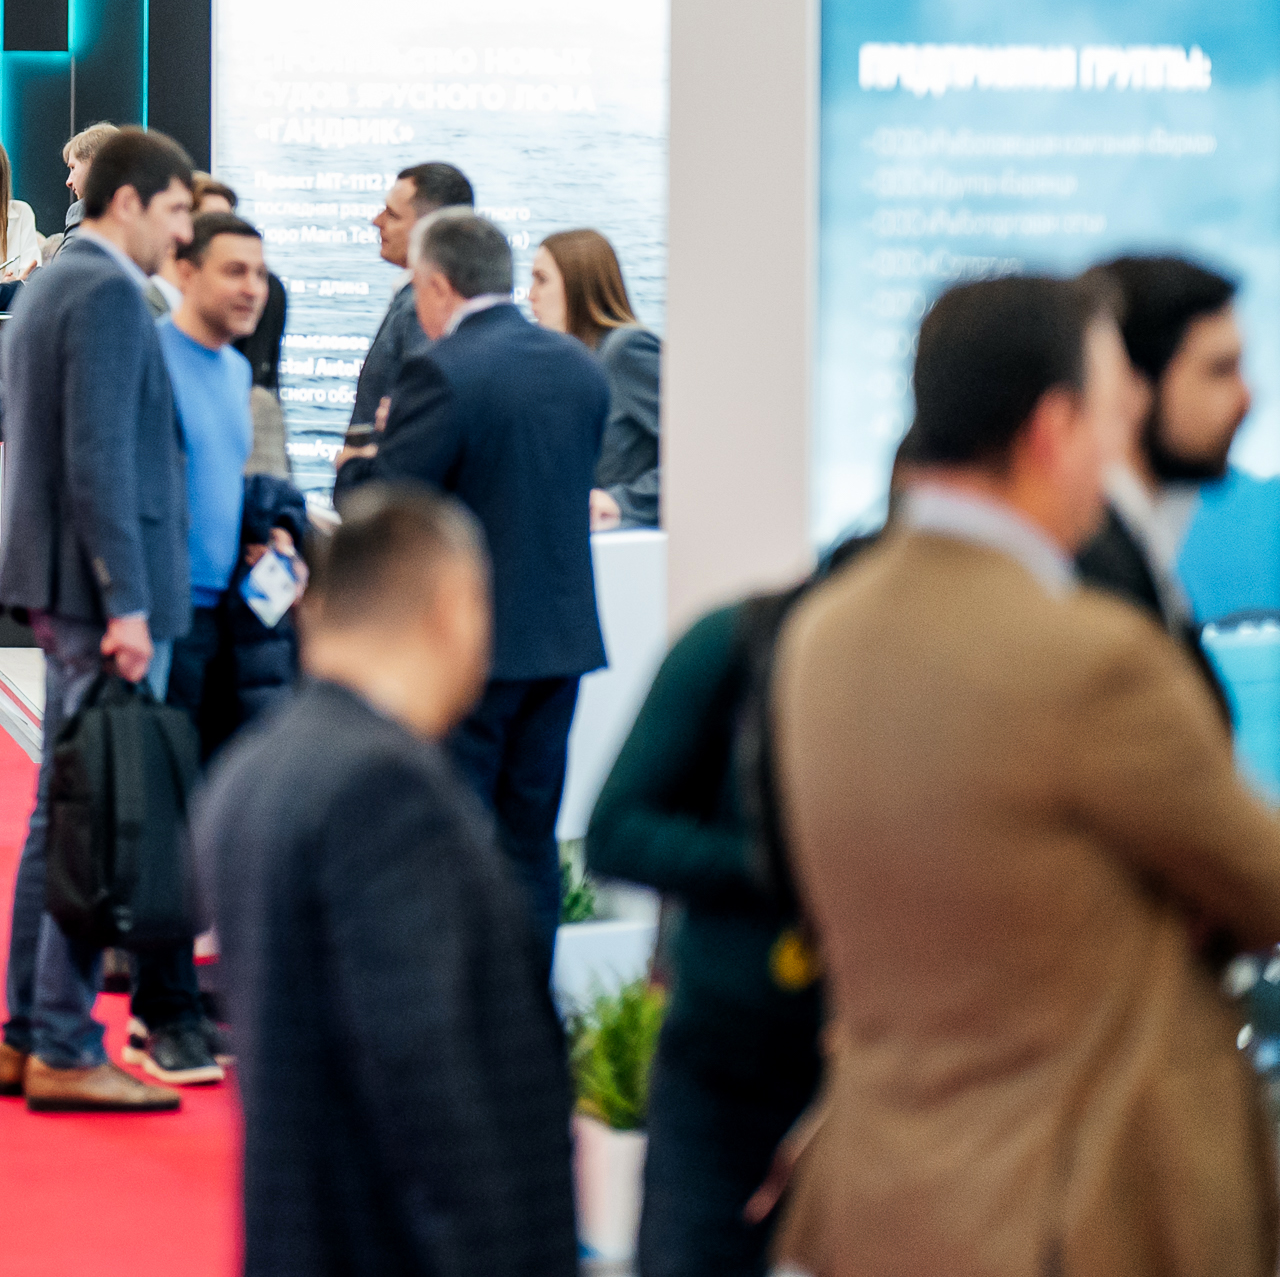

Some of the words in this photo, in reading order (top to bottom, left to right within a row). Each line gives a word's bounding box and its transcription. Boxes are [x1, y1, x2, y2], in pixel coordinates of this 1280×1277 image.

[356, 82, 507, 111] ЯРУСНОГО
[512, 83, 598, 113] ЛОВА
[254, 117, 416, 149] «ГАНДВИК»
[301, 226, 347, 243] Marin
[281, 335, 370, 351] мысловое
